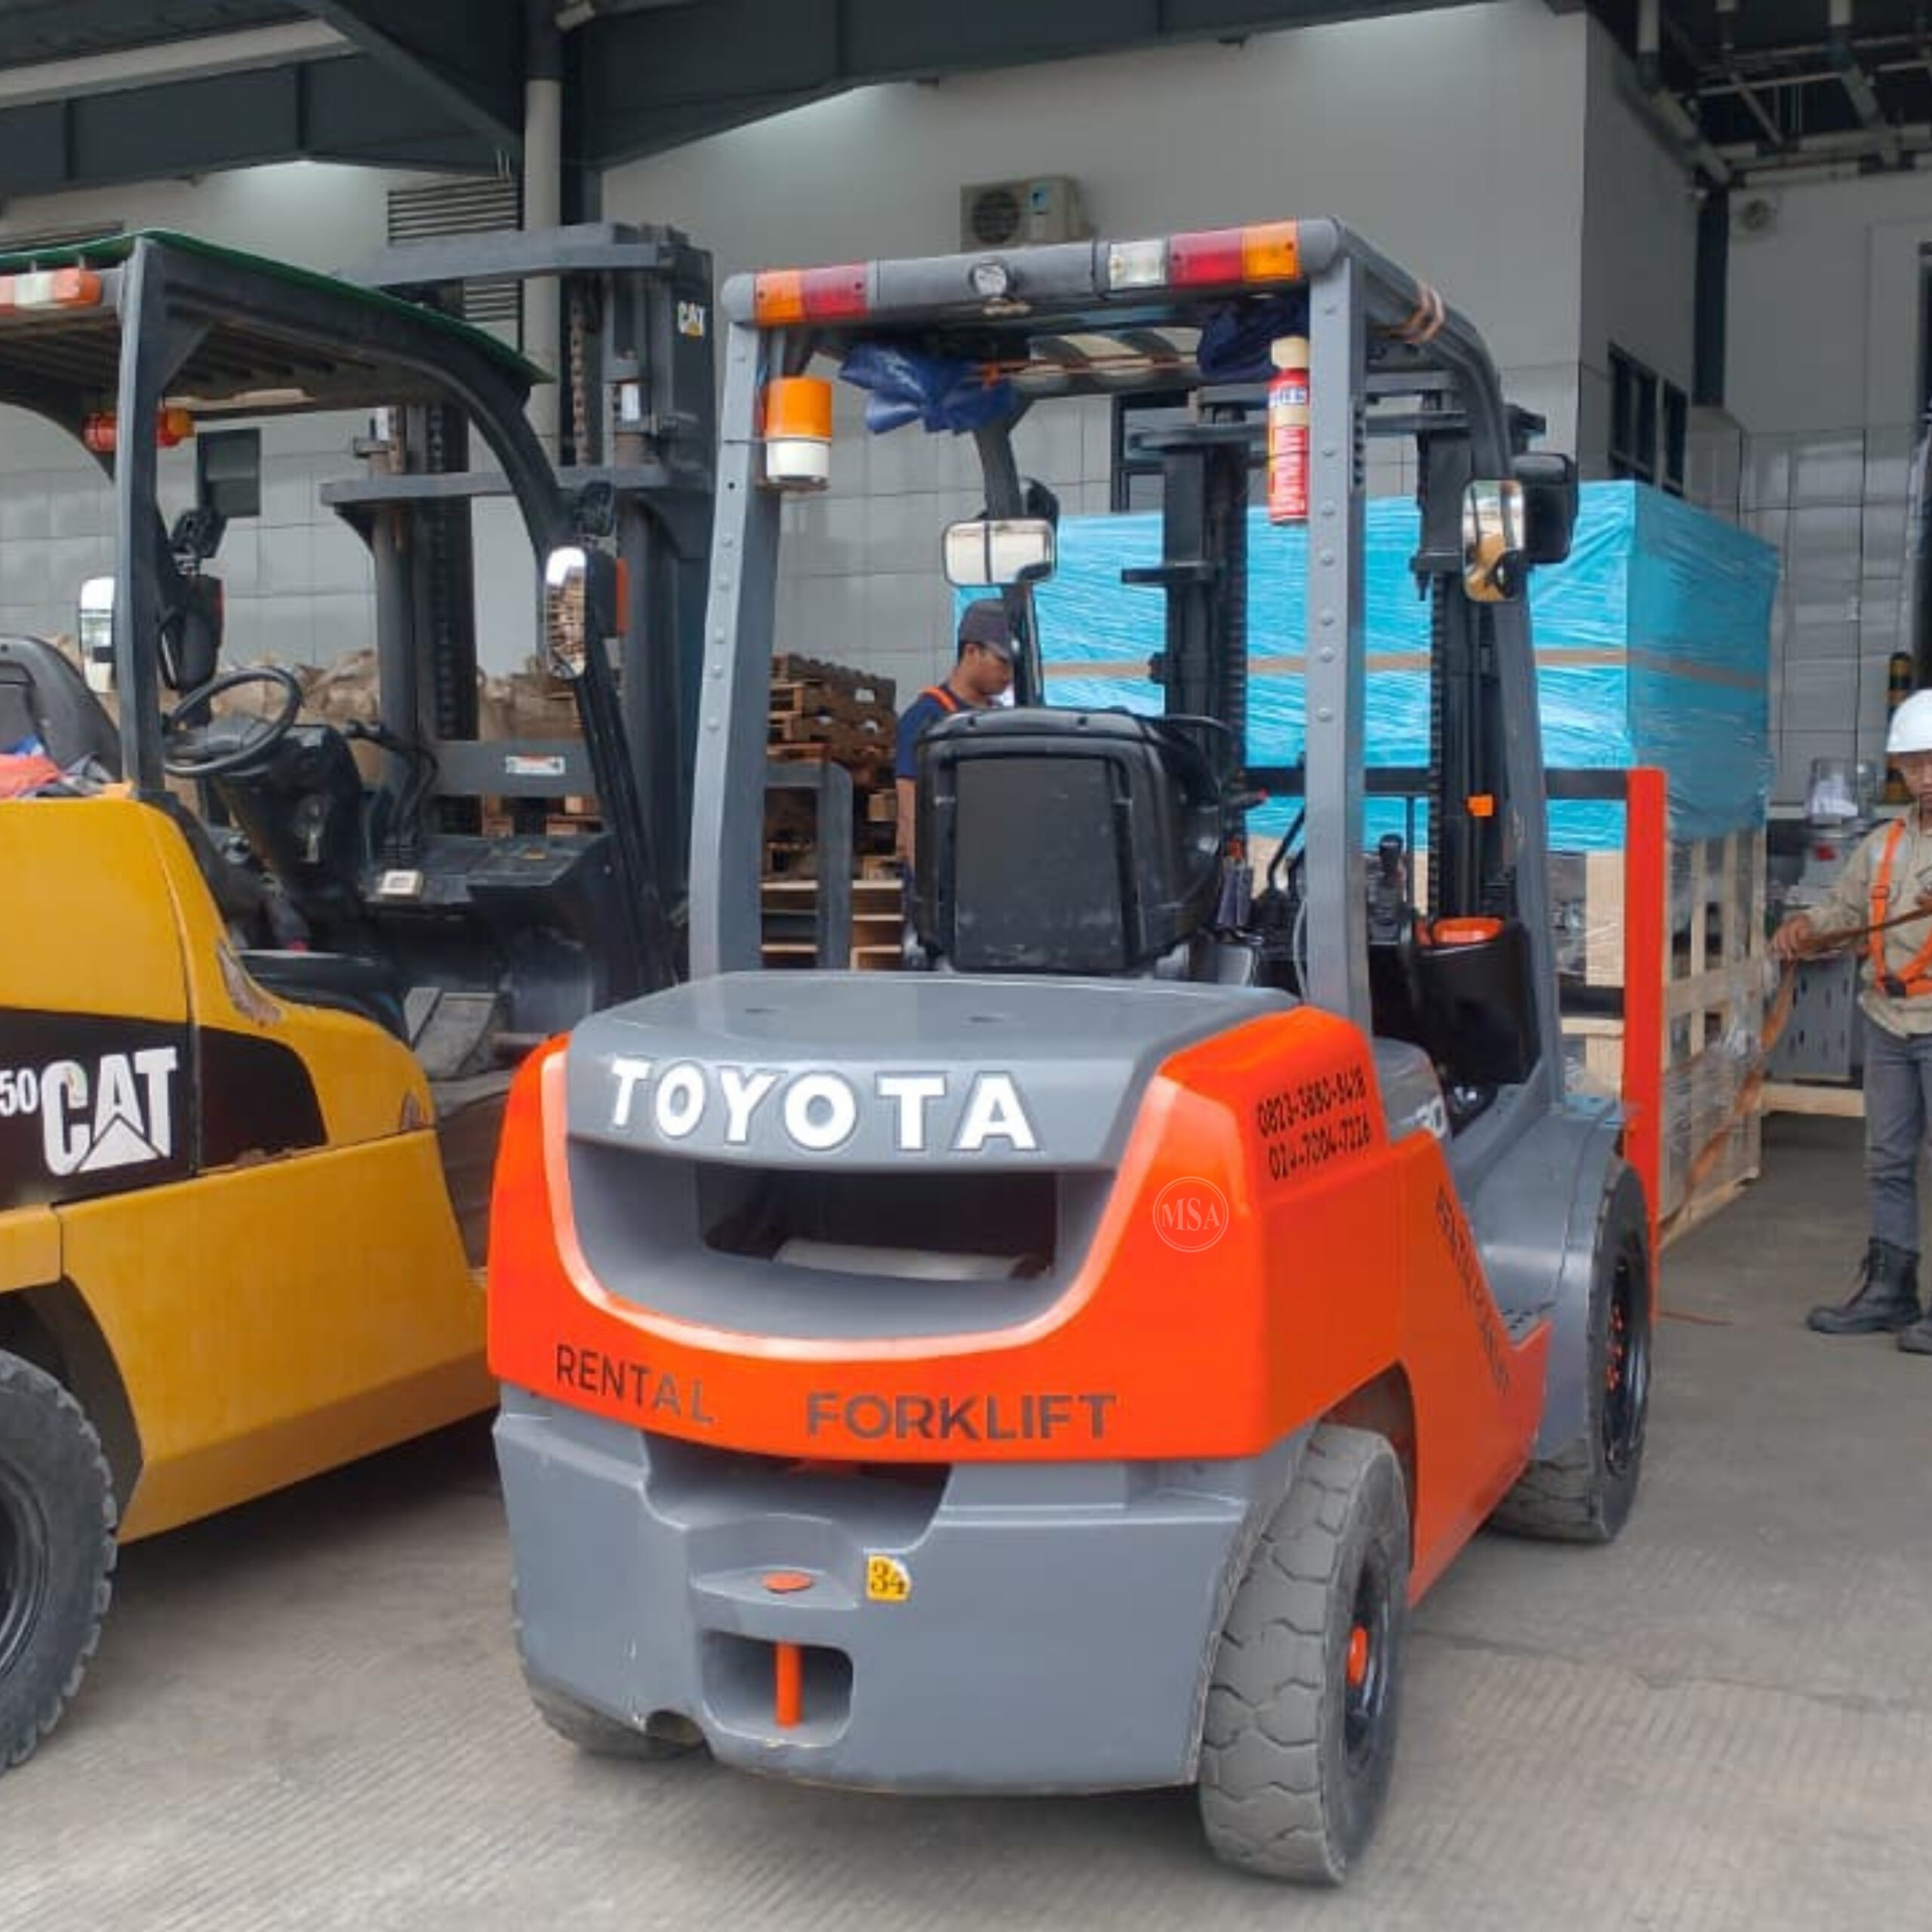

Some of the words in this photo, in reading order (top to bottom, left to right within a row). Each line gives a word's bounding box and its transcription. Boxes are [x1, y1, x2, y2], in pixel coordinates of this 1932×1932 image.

[678, 300, 705, 336] CAT
[42, 1047, 177, 1176] CAT
[611, 1057, 1041, 1151] TOYOTA
[556, 1343, 714, 1426] RENTAL
[805, 1392, 1117, 1440] FORKLIFT
